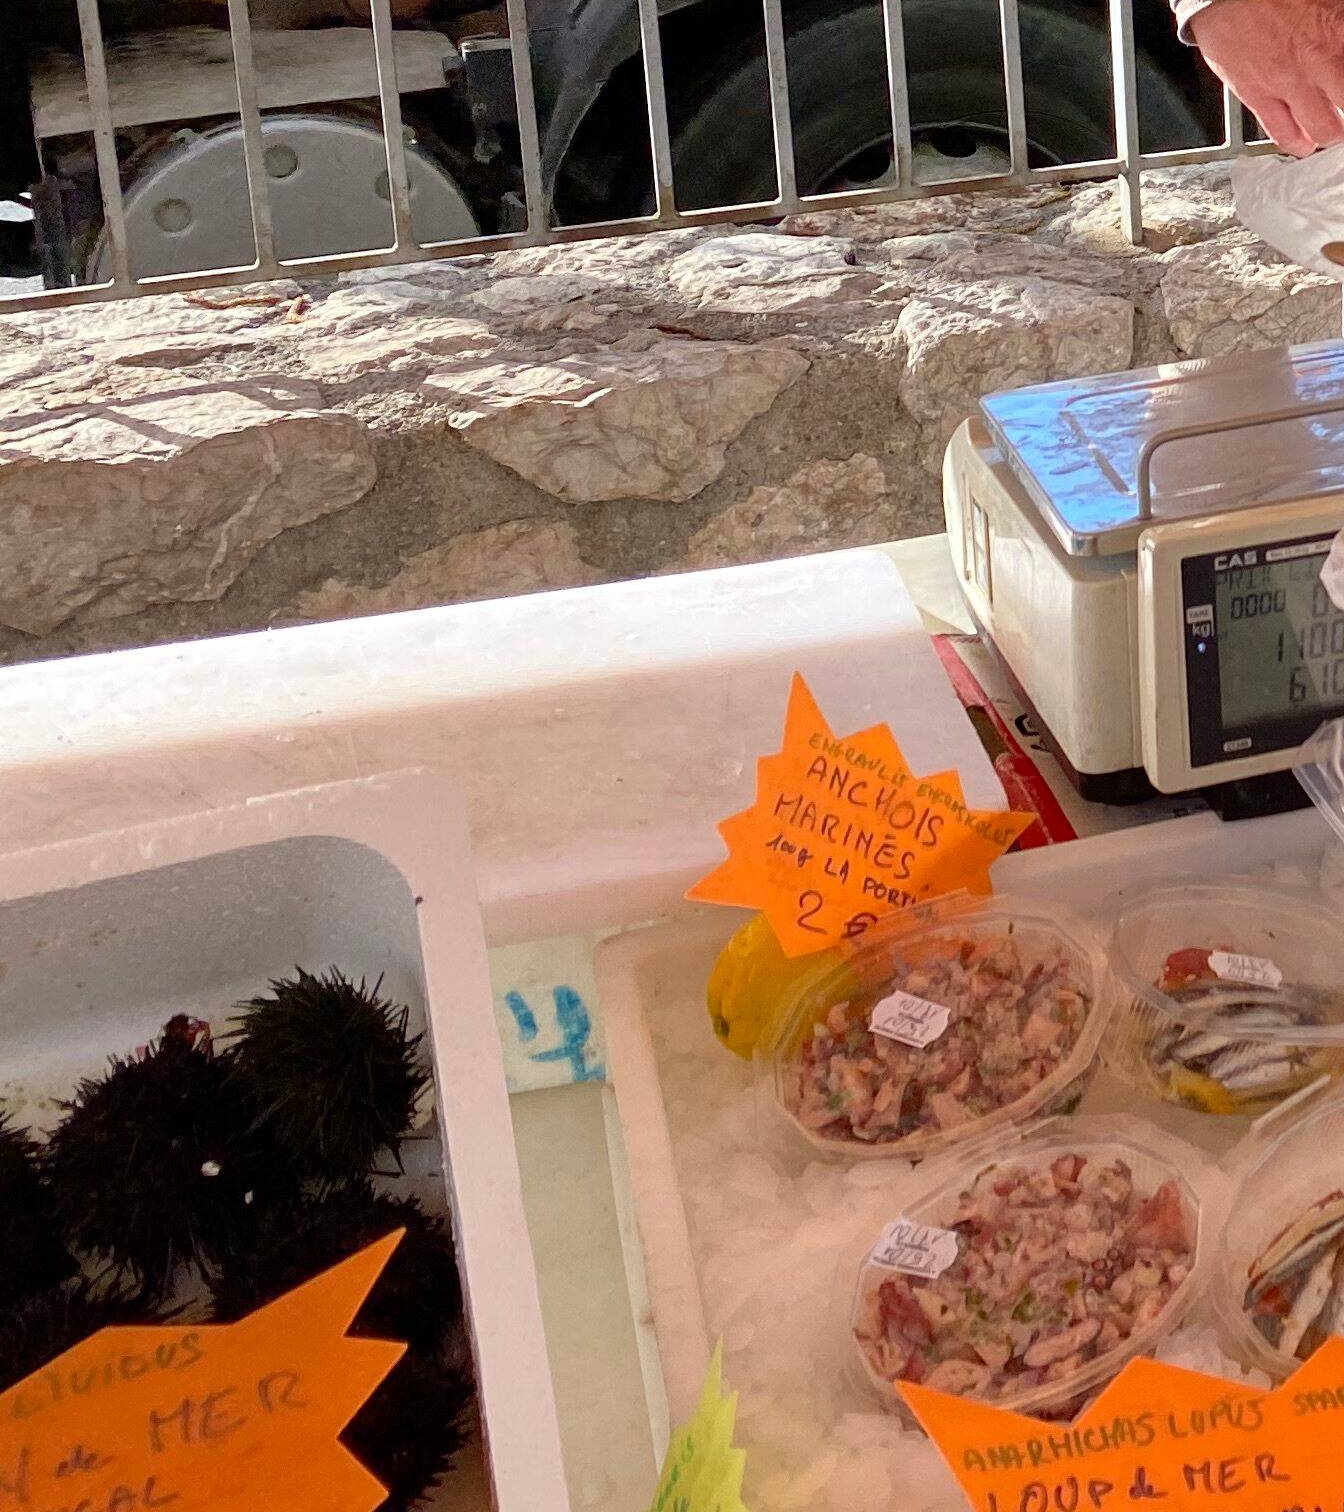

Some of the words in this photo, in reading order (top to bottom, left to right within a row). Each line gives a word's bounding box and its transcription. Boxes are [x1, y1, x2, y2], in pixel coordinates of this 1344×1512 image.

[1213, 550, 1257, 572] CAS
[805, 754, 945, 849] ANCHOIS
[148, 1371, 309, 1456] MER
[1167, 1393, 1267, 1440] LUPUS
[1182, 1449, 1293, 1494] MER
